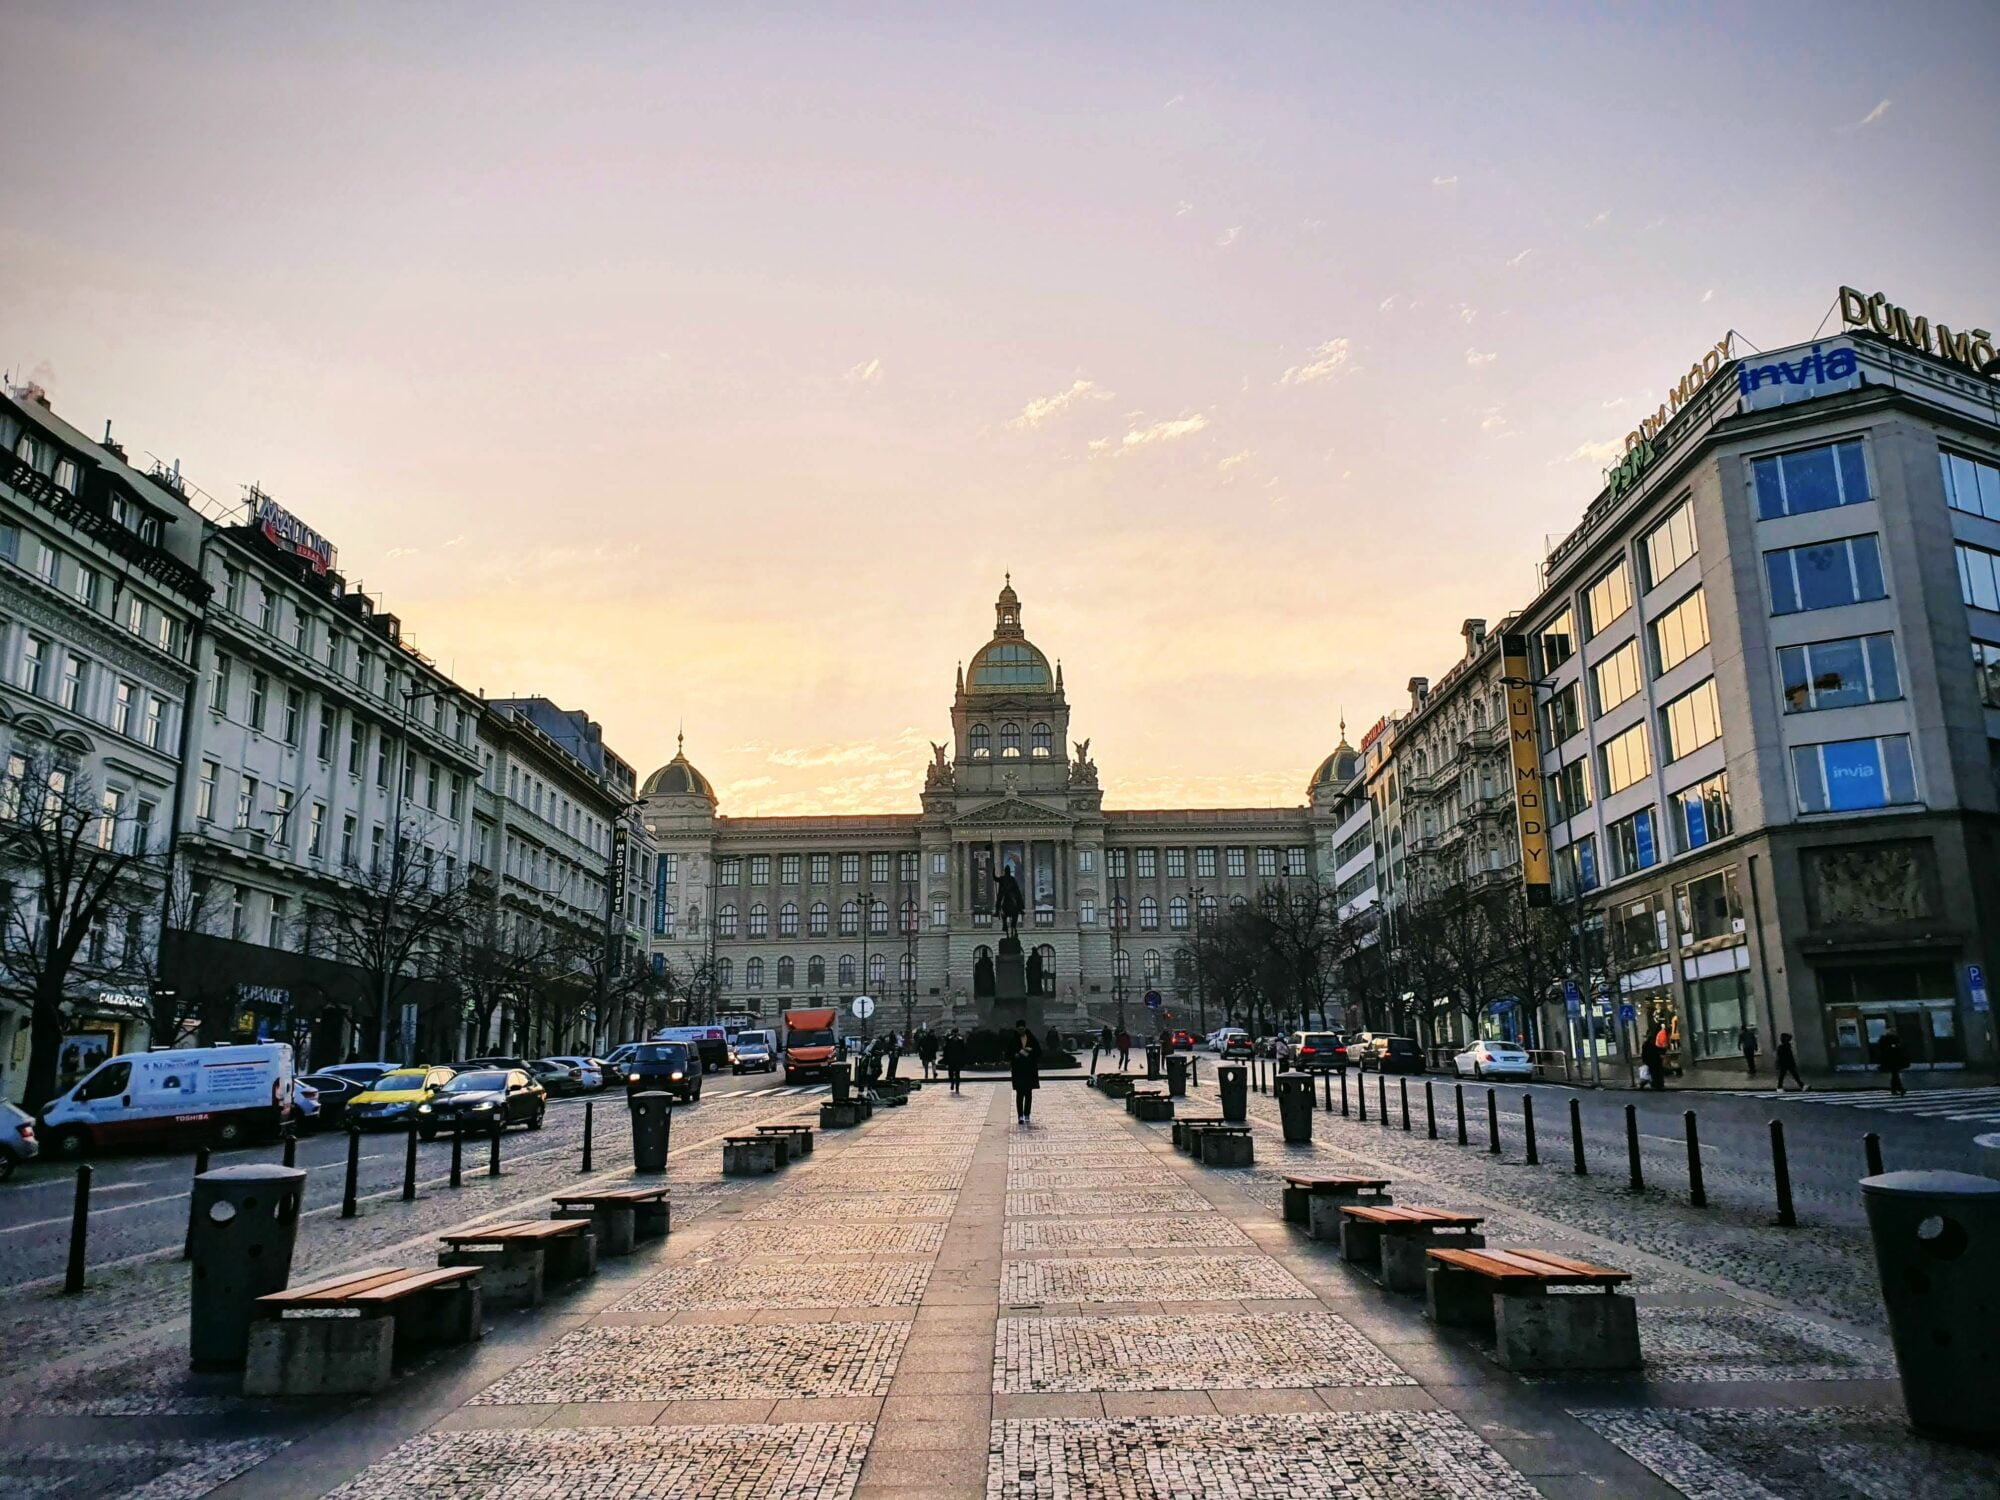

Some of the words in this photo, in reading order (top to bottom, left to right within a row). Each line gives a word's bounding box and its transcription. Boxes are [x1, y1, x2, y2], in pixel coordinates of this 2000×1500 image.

[1738, 344, 1857, 396] invia
[1833, 763, 1875, 778] invia
[1517, 767, 1542, 862] MÓDY
[1970, 967, 1980, 980] P
[1567, 982, 1574, 993] P
[175, 1113, 209, 1122] TOSHIBA
